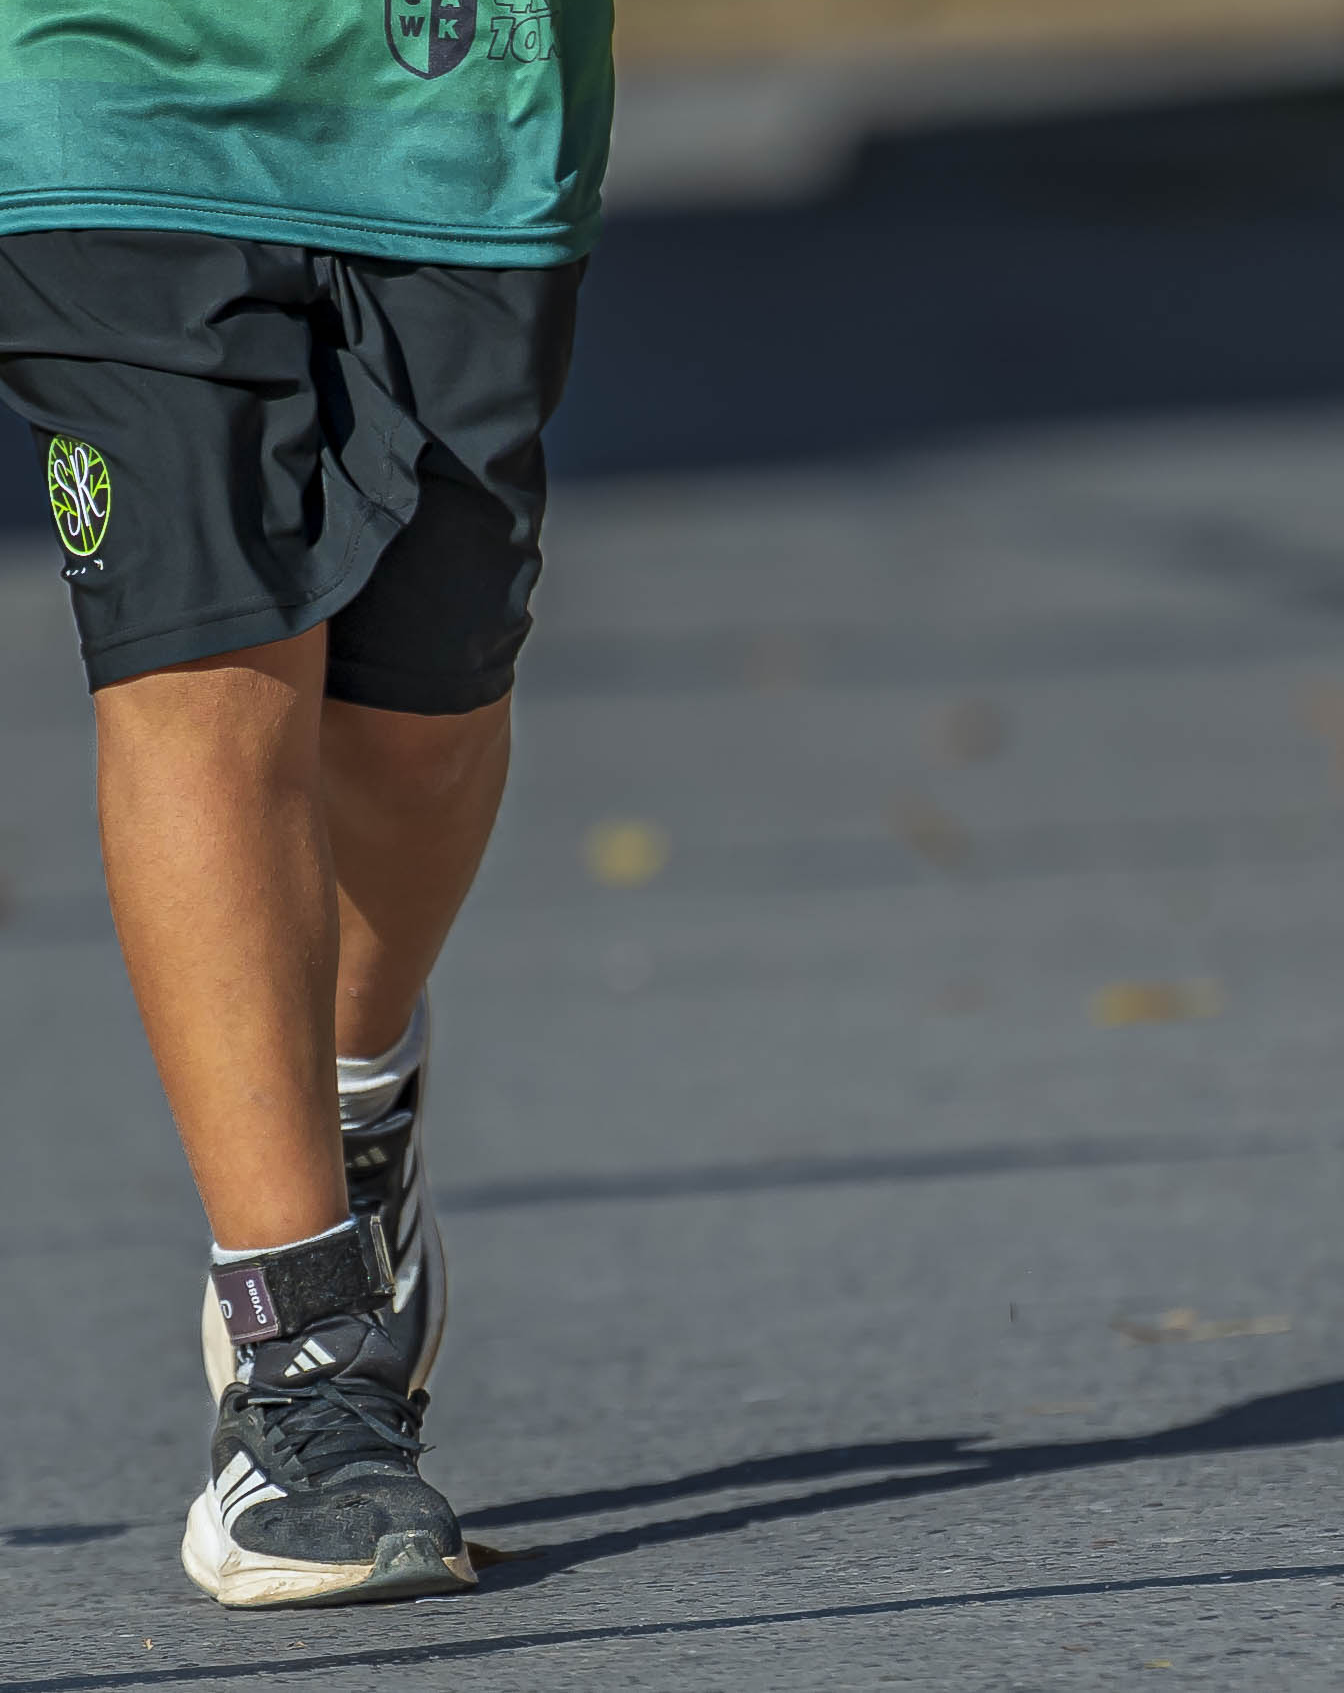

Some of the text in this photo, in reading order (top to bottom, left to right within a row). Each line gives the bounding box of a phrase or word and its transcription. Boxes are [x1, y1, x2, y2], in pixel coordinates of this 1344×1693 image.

[398, 15, 459, 39] W K
[245, 1279, 268, 1325] CV086
